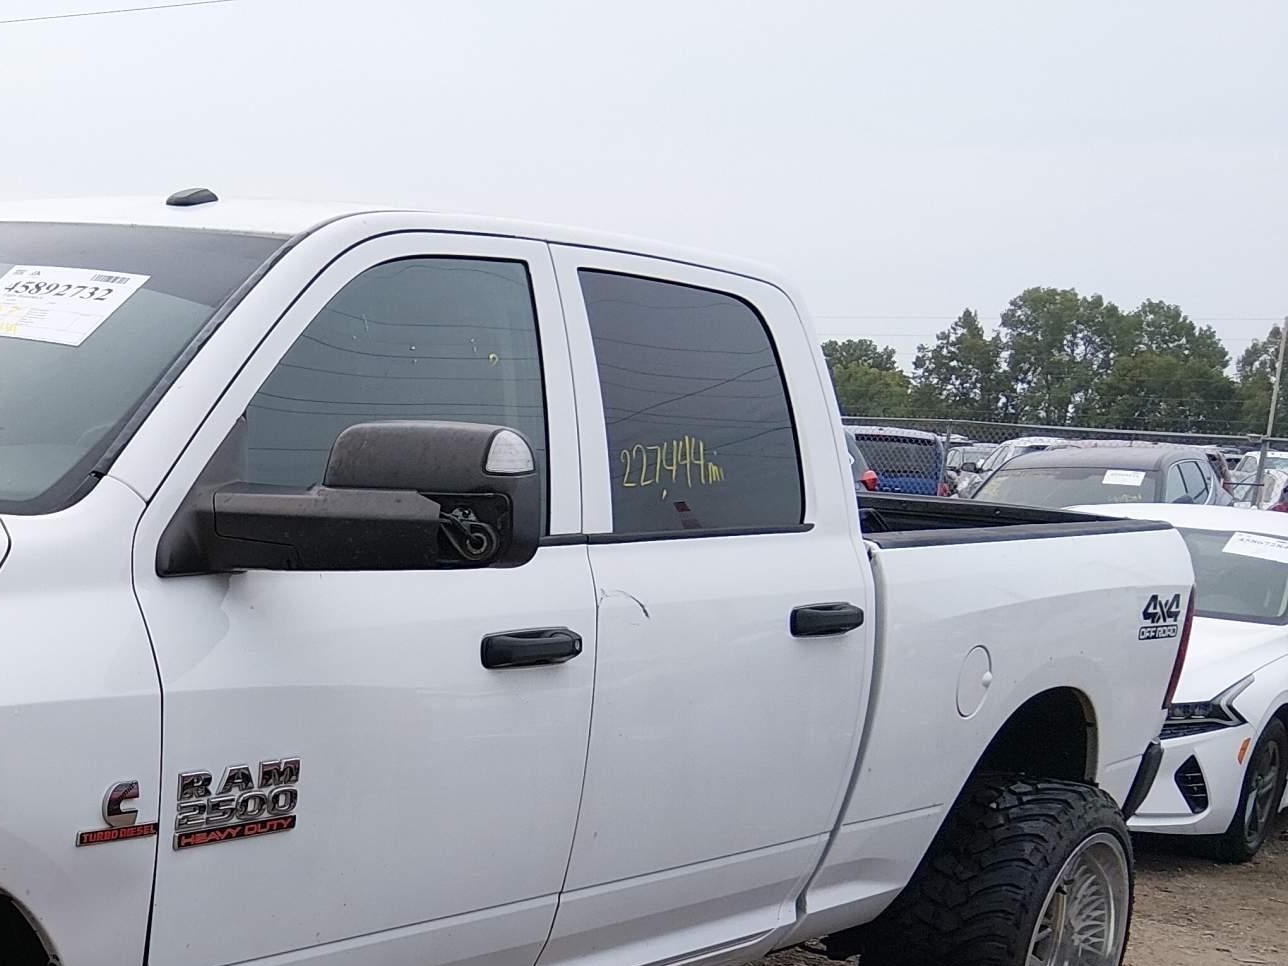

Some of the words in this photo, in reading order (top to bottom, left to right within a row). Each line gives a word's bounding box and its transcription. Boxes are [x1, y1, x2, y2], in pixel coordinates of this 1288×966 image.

[4, 280, 114, 301] 45892732
[1140, 627, 1156, 639] OFF
[177, 757, 300, 801] RAM
[174, 785, 298, 831] 2500
[82, 829, 119, 843] TURBO
[119, 824, 155, 837] DIESEL
[180, 826, 242, 846] HEAVY
[244, 817, 293, 836] DUTY
